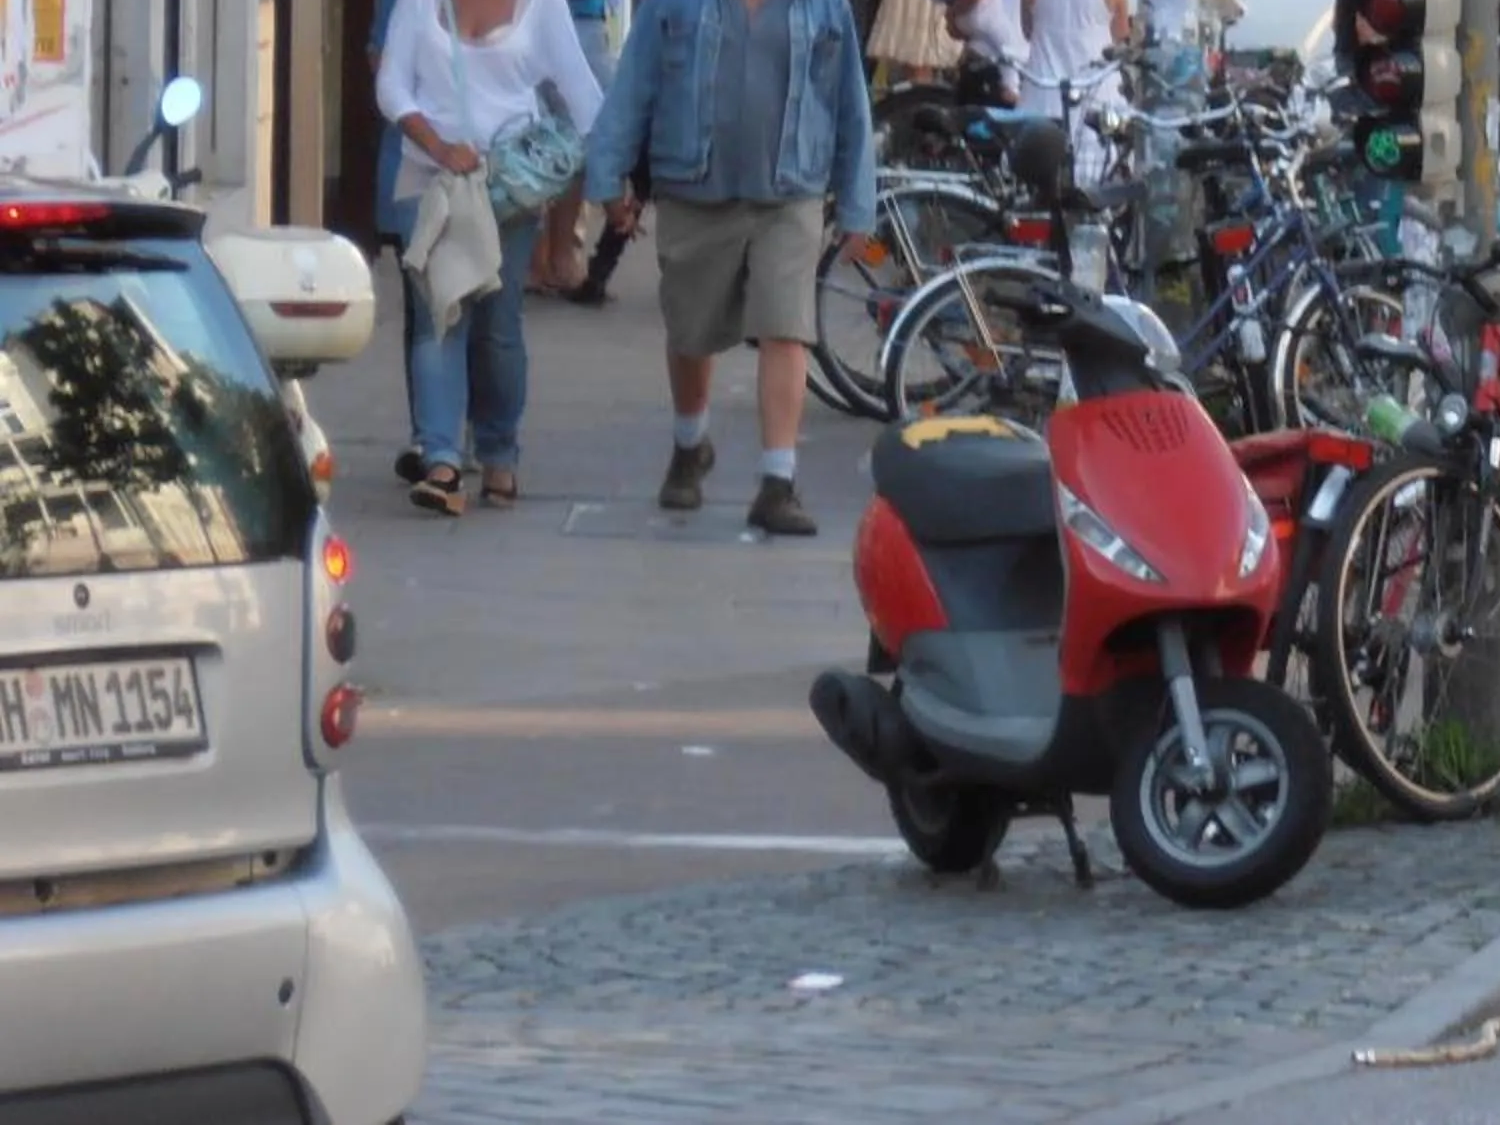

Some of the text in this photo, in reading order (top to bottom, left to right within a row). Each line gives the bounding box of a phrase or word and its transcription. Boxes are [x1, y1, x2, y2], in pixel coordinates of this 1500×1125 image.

[0, 666, 194, 743] H MN 1154
